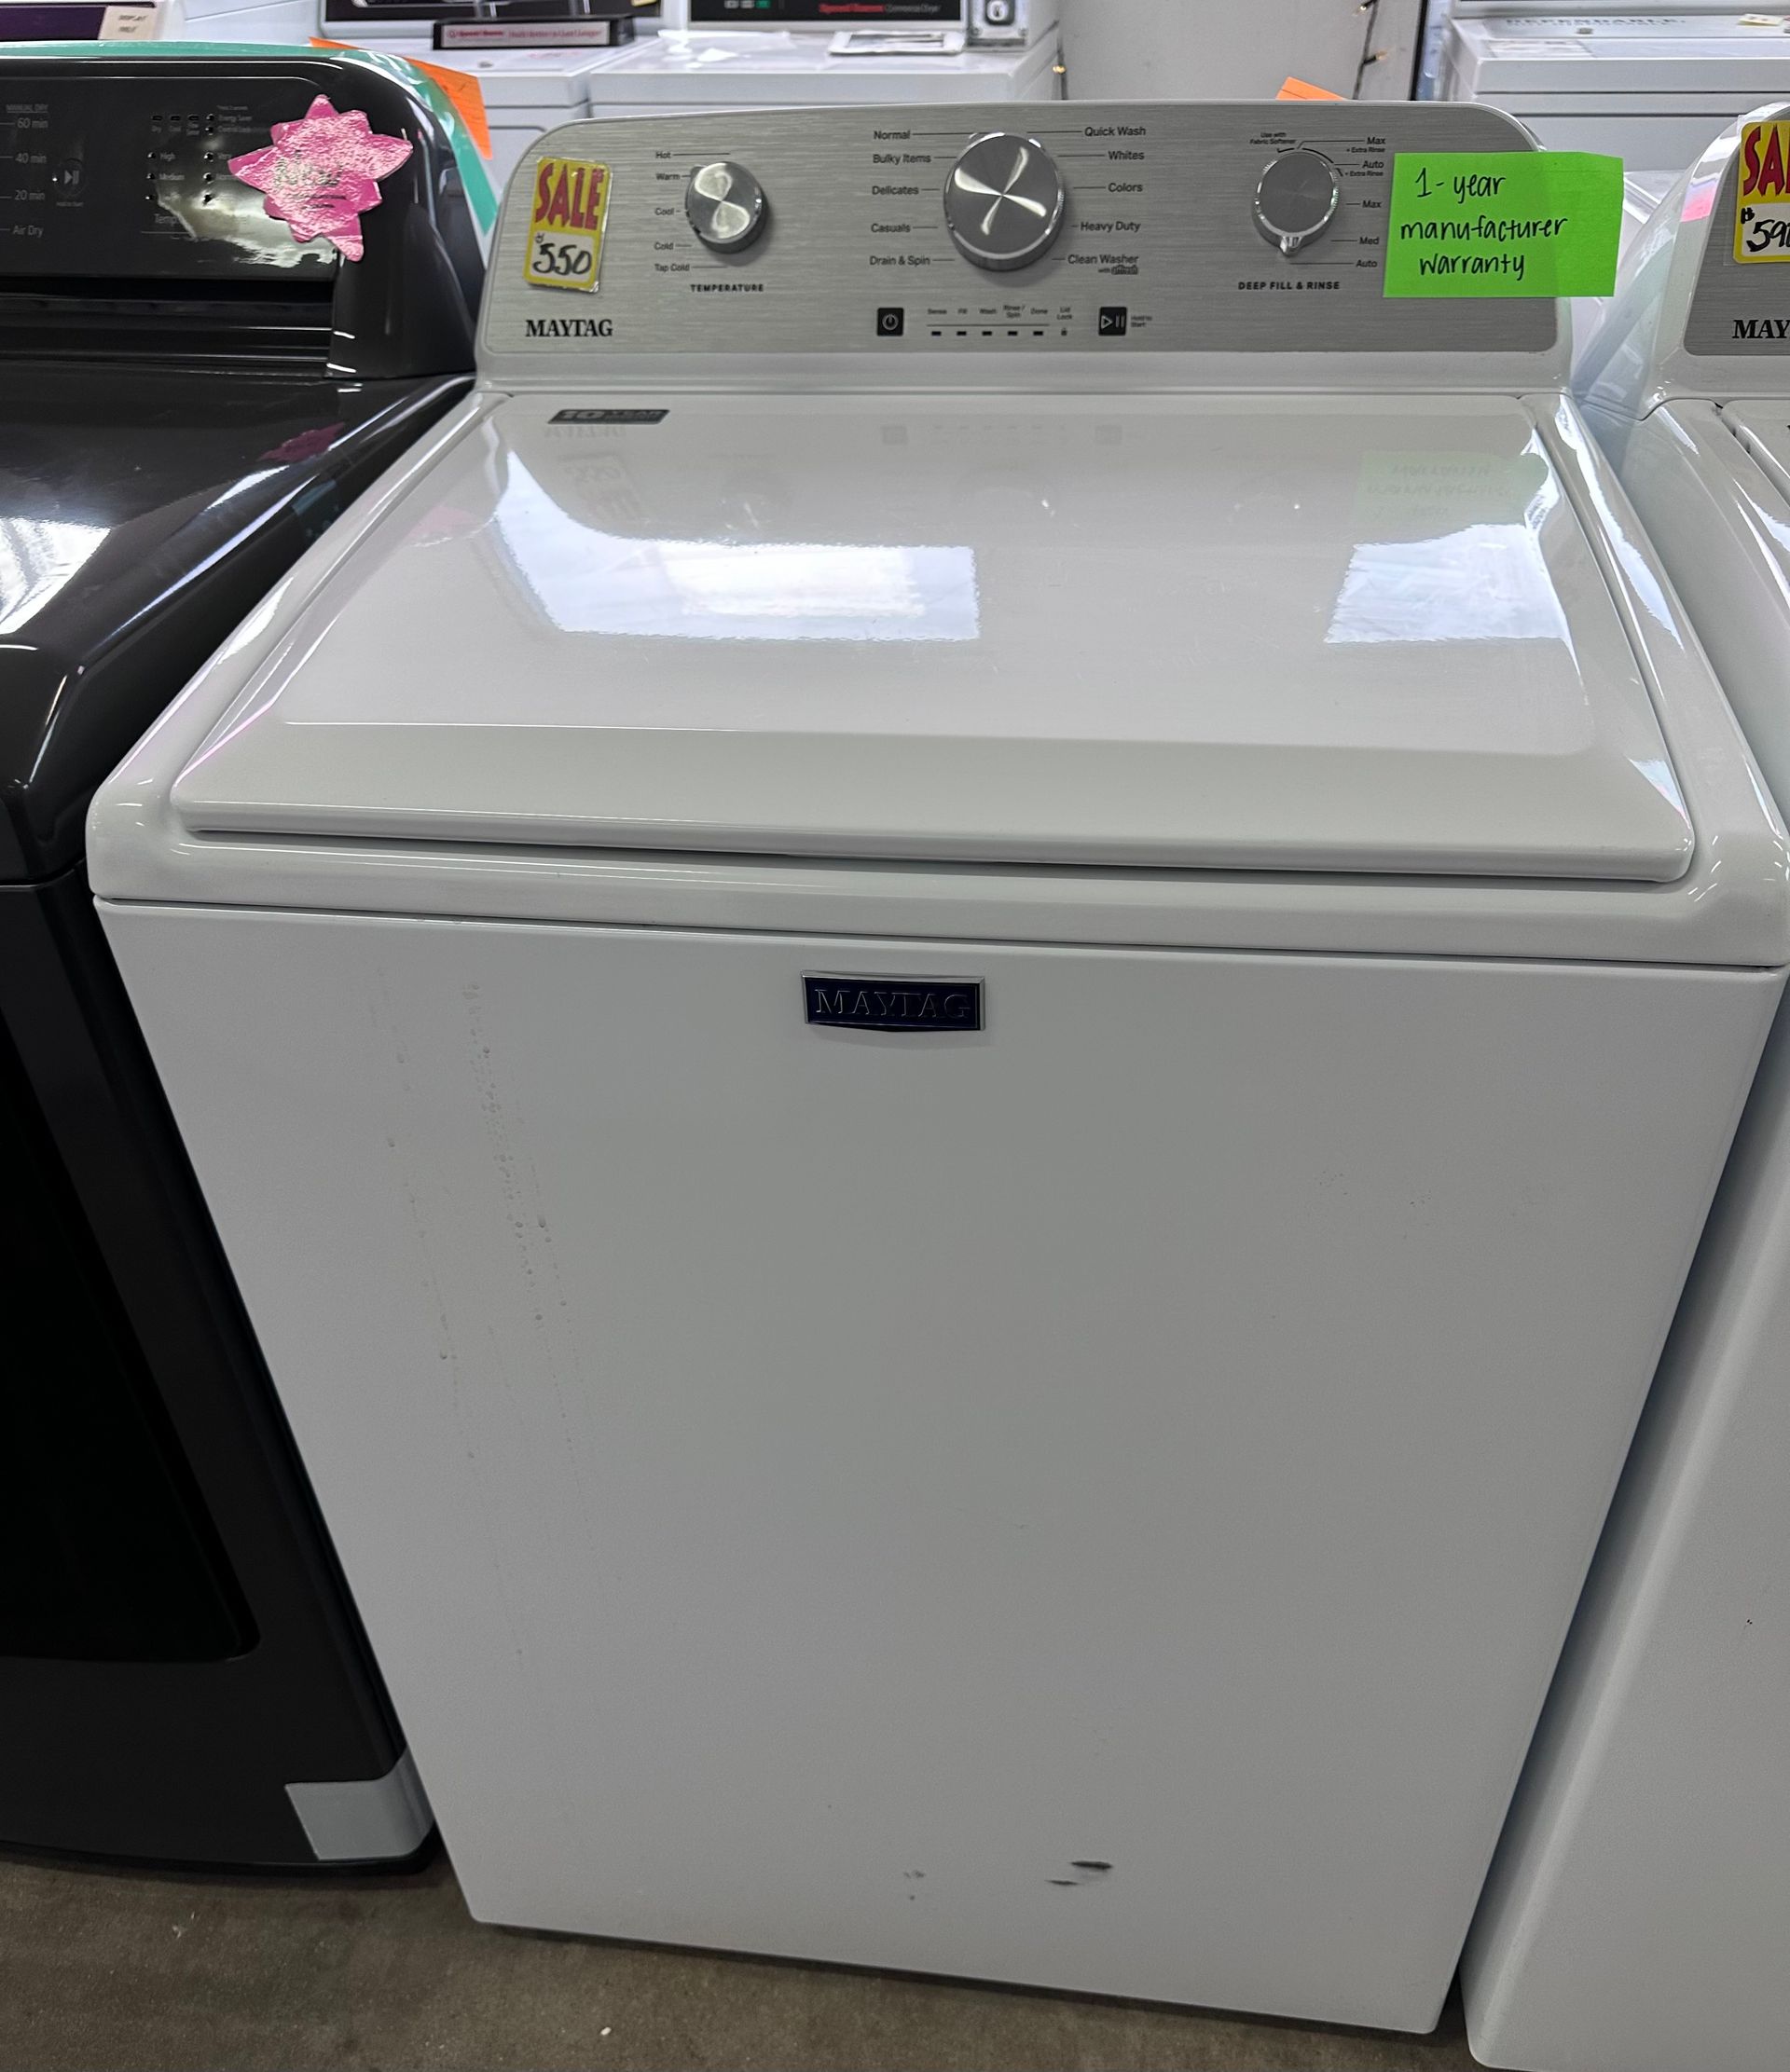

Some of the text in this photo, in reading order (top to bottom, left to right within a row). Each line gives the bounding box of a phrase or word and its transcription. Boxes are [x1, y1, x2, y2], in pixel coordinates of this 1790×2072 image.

[17, 117, 31, 129] 60
[873, 130, 911, 140] Normal
[1084, 127, 1147, 137] Quick Wash
[1367, 137, 1386, 145] Max
[655, 151, 672, 159] Hot
[873, 154, 932, 165] Bulky Items
[1108, 150, 1146, 160] Whites
[1362, 160, 1384, 170] Auto
[1742, 125, 1790, 197] SA
[872, 185, 919, 196] Delicates
[1108, 183, 1144, 192] Colors
[534, 162, 605, 230] SALE
[1362, 199, 1383, 209] Max
[871, 223, 911, 233] Casuals
[1080, 221, 1141, 233] Heavy Duty
[1400, 214, 1568, 242] manufacturer
[654, 241, 674, 251] Cold
[1359, 237, 1380, 245] Med
[869, 255, 930, 268] Drain & Spin
[1067, 254, 1139, 265] Clean Washer
[1356, 259, 1378, 268] Auto
[654, 264, 690, 272] Tap Cold
[1419, 253, 1525, 281] warranty
[690, 284, 764, 293] TEMPERATURE
[1238, 281, 1341, 290] DEEP FILL & RINSE
[525, 319, 613, 337] MAYTAG
[814, 988, 971, 1019] MAYTAG
